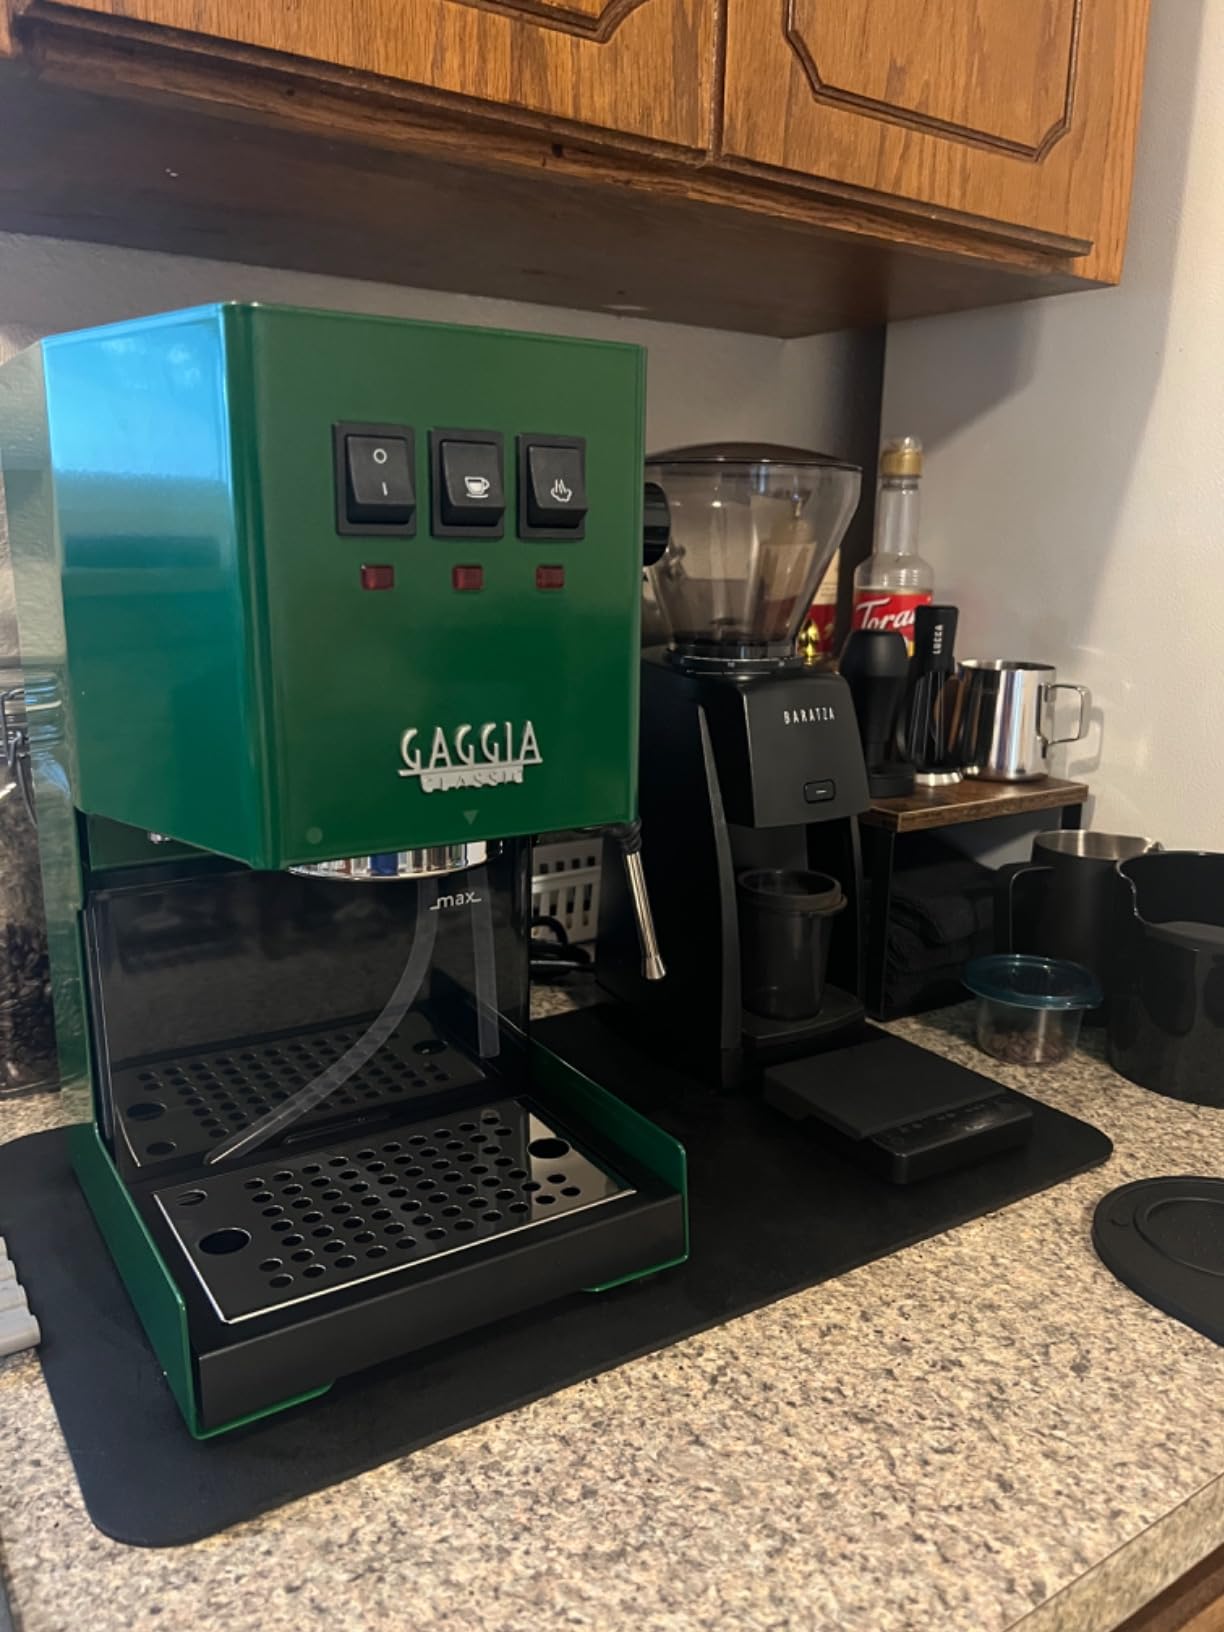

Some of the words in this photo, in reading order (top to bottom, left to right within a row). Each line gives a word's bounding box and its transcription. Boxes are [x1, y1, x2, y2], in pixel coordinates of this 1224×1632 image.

[783, 706, 836, 725] BARATZA
[400, 720, 541, 772] GAGGIA
[433, 891, 479, 910] max
